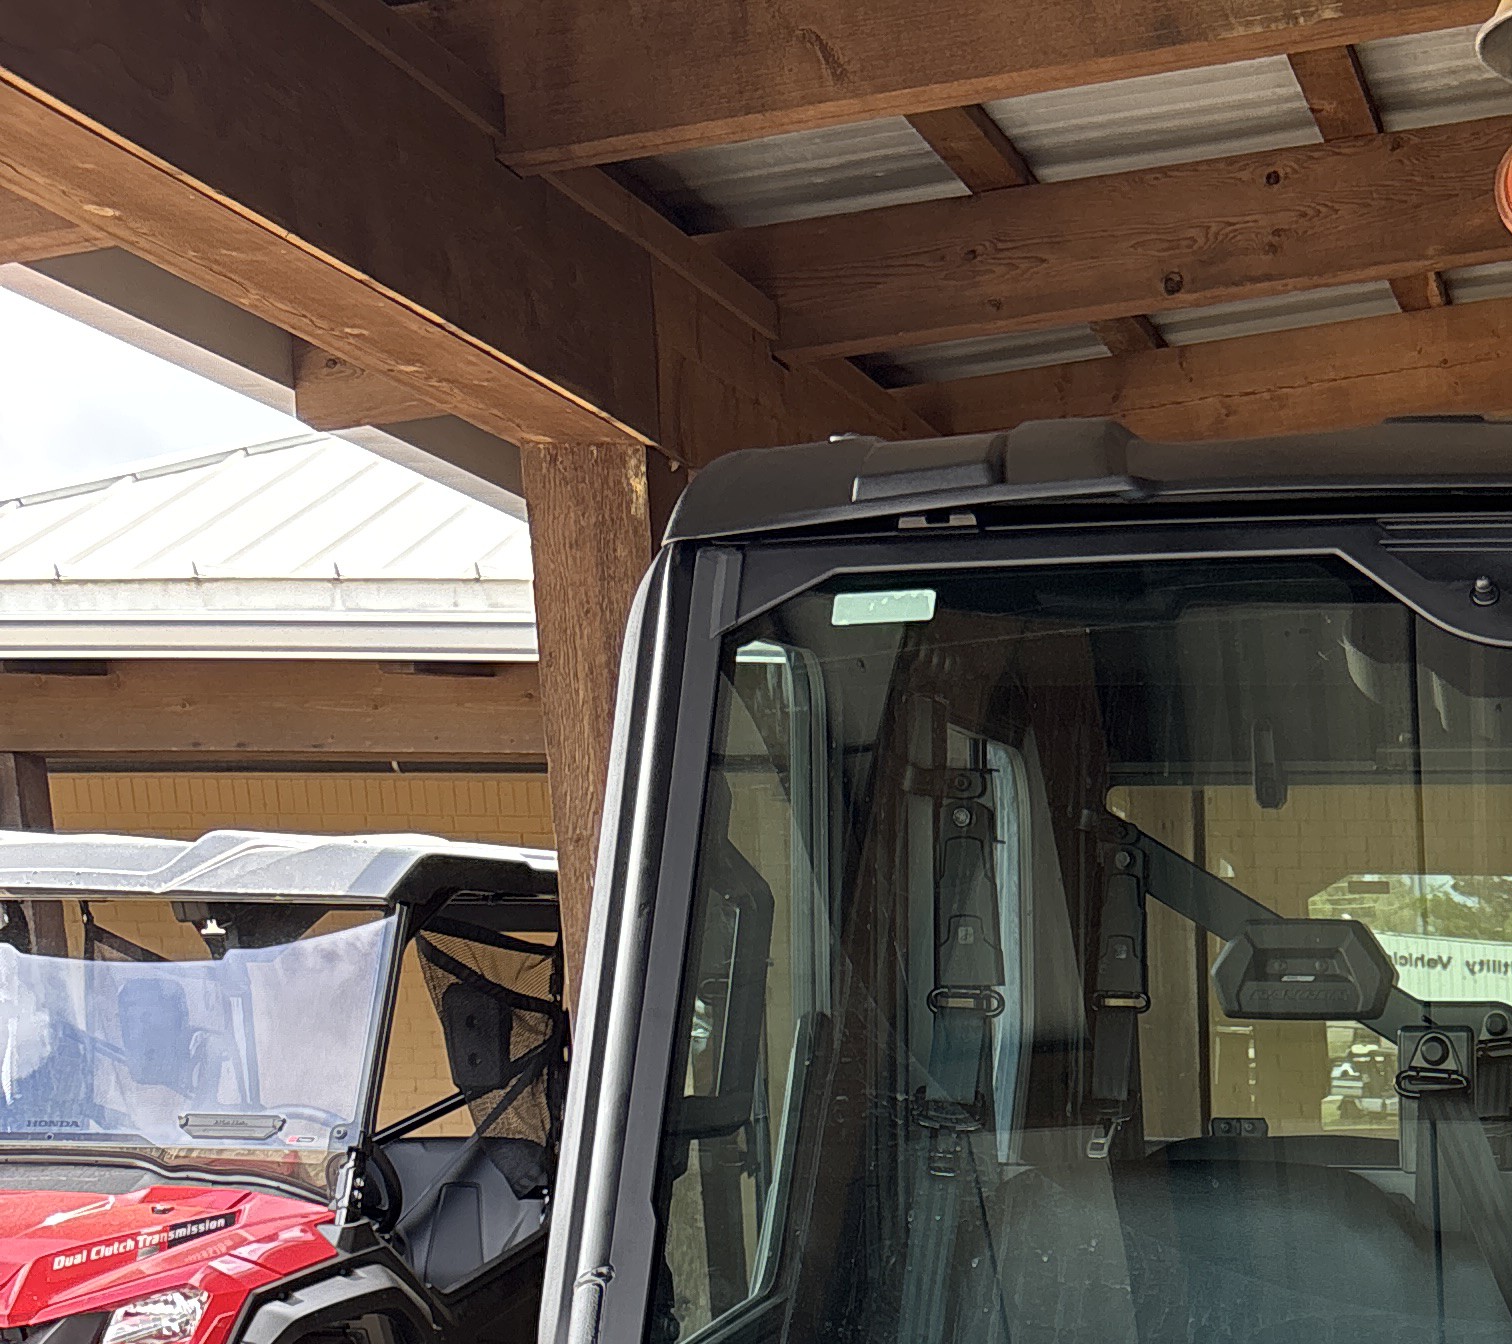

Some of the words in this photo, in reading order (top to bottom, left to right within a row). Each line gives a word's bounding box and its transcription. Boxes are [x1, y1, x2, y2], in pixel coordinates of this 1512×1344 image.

[26, 1119, 80, 1129] HONDA
[53, 1249, 88, 1271] Dual
[90, 1238, 136, 1261] Clutch
[135, 1217, 226, 1249] Transmission
